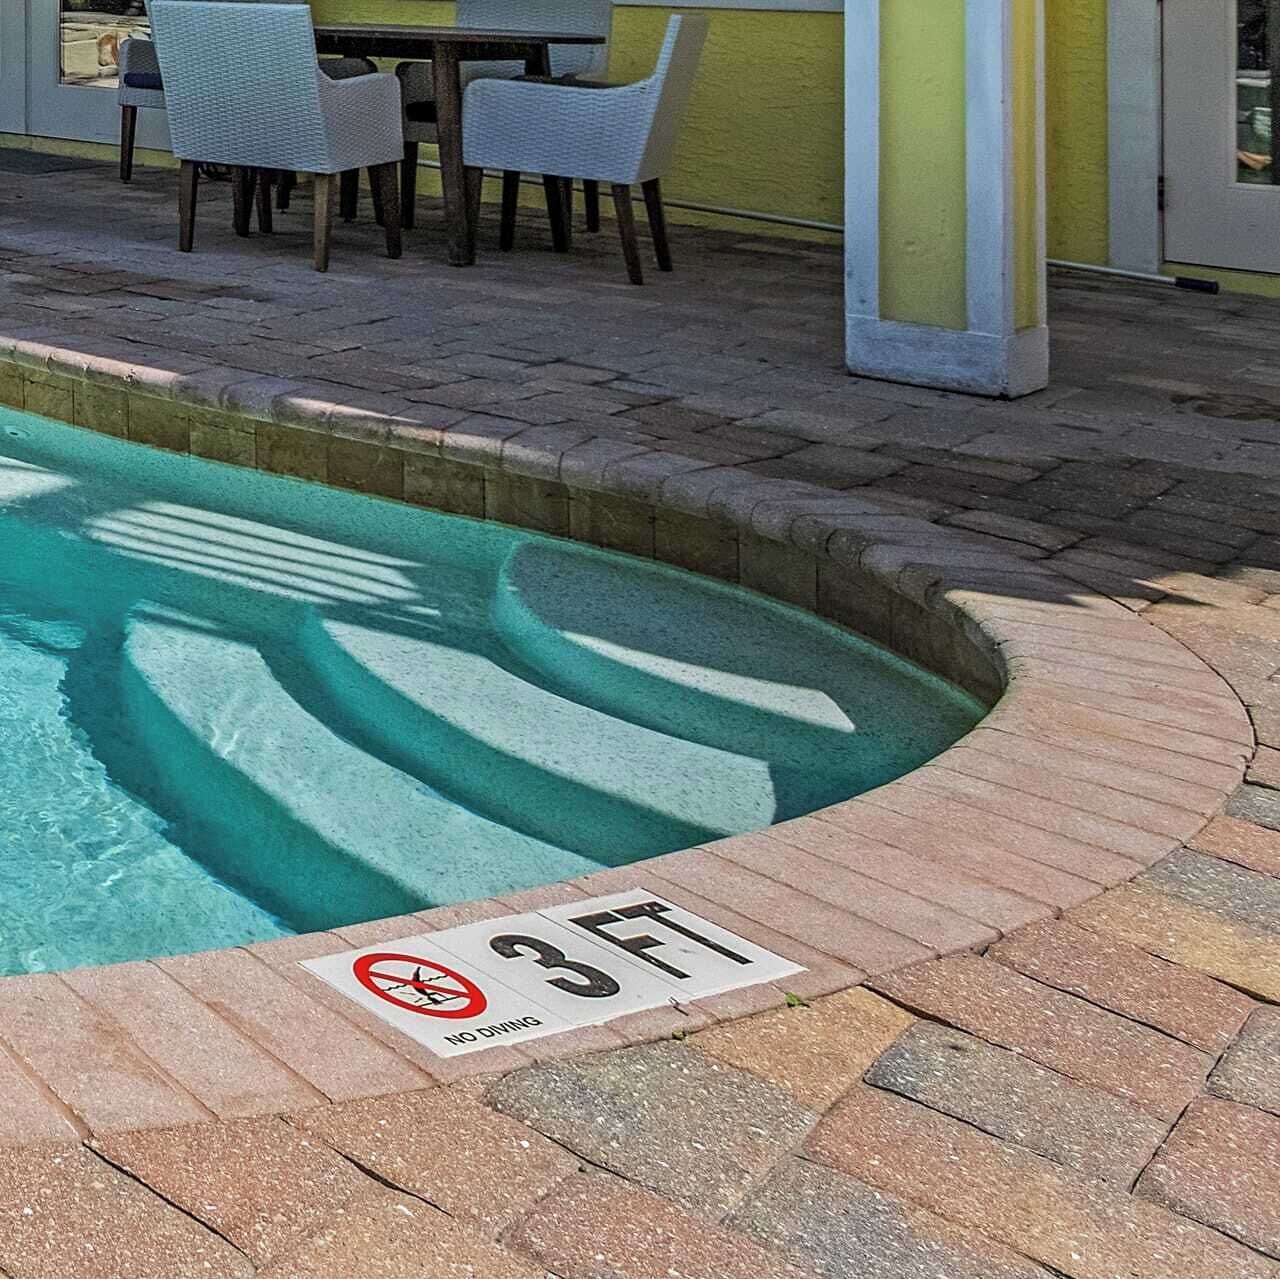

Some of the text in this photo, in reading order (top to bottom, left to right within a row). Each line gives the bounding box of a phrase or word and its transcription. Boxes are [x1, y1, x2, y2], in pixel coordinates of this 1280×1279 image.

[489, 901, 754, 998] 3 FT
[443, 1015, 543, 1046] NO DIVING
